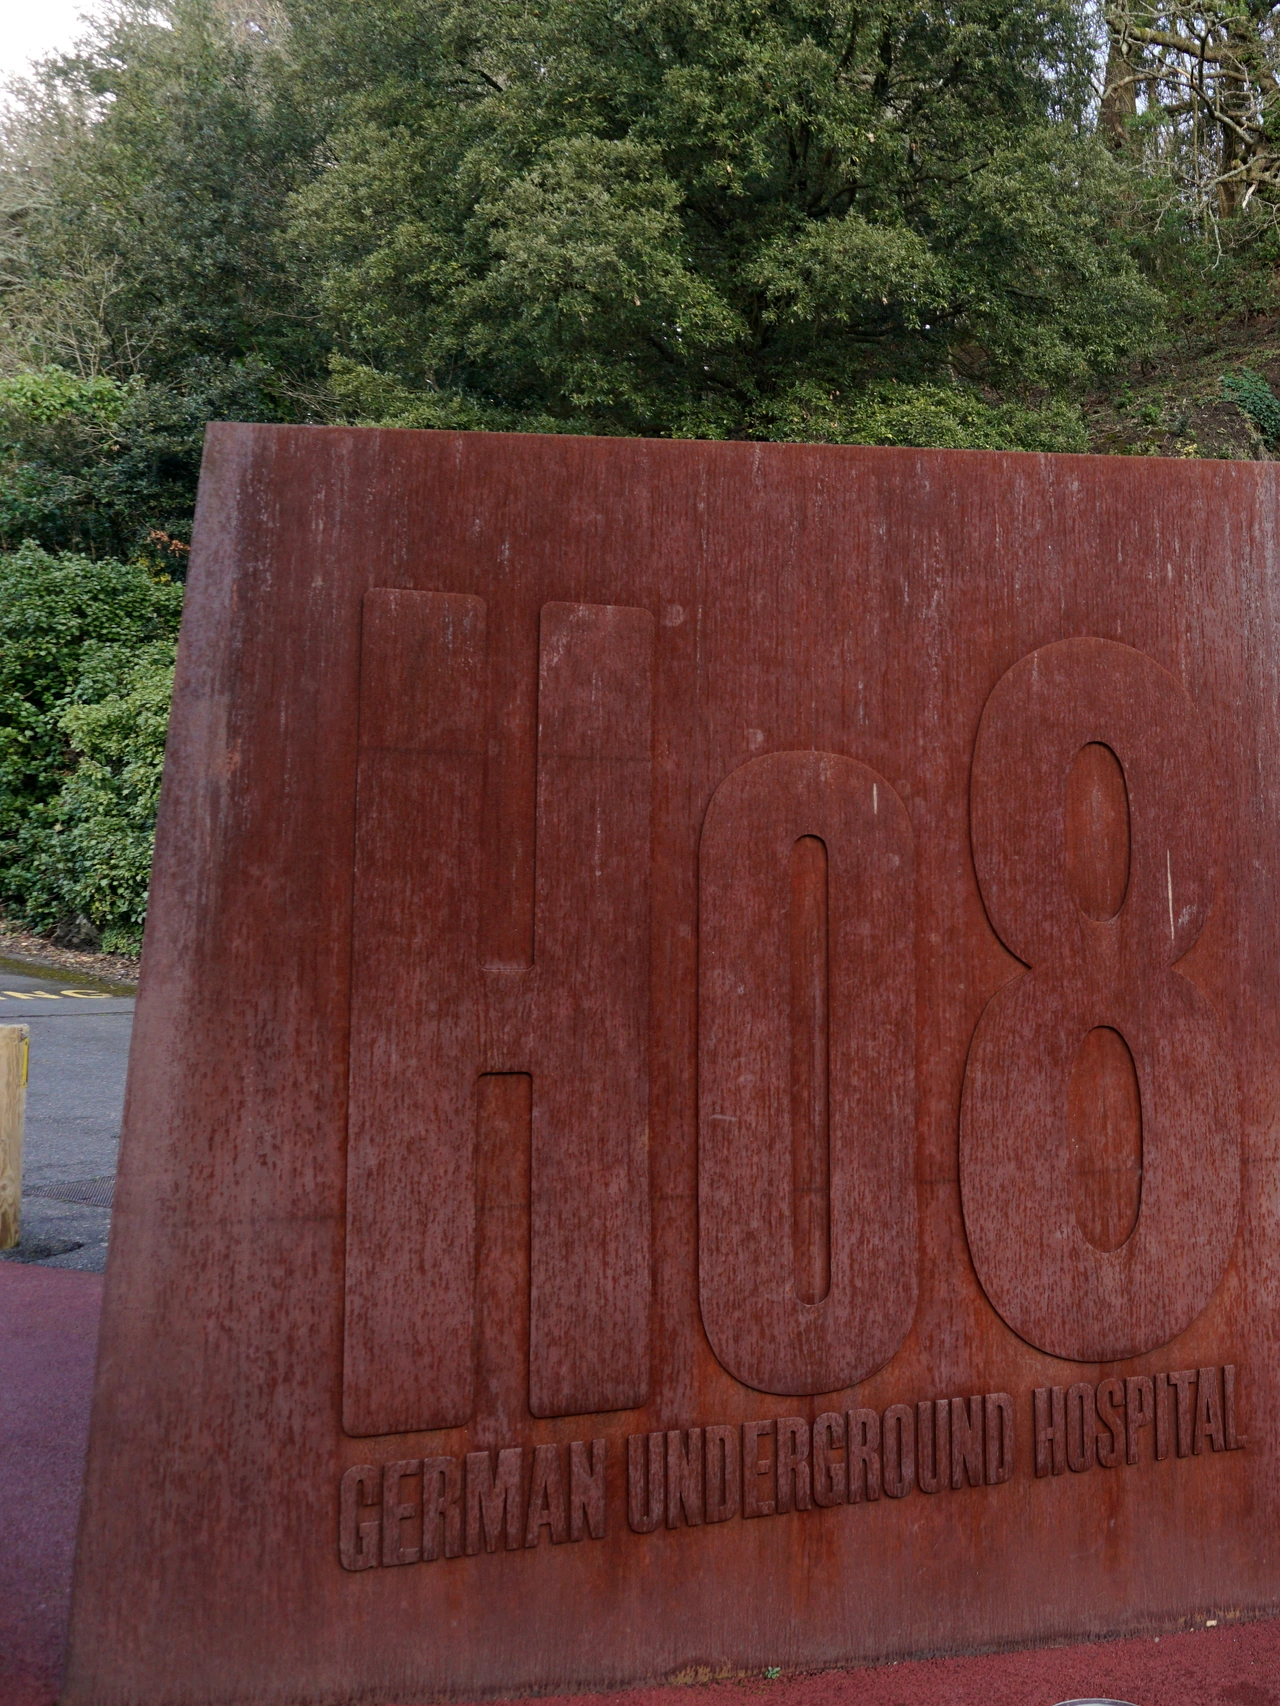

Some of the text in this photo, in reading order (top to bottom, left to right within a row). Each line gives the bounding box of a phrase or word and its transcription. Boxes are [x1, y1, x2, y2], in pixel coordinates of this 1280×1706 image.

[338, 1363, 1248, 1572] GERMAN UNDERGROUND HOSPITAL
